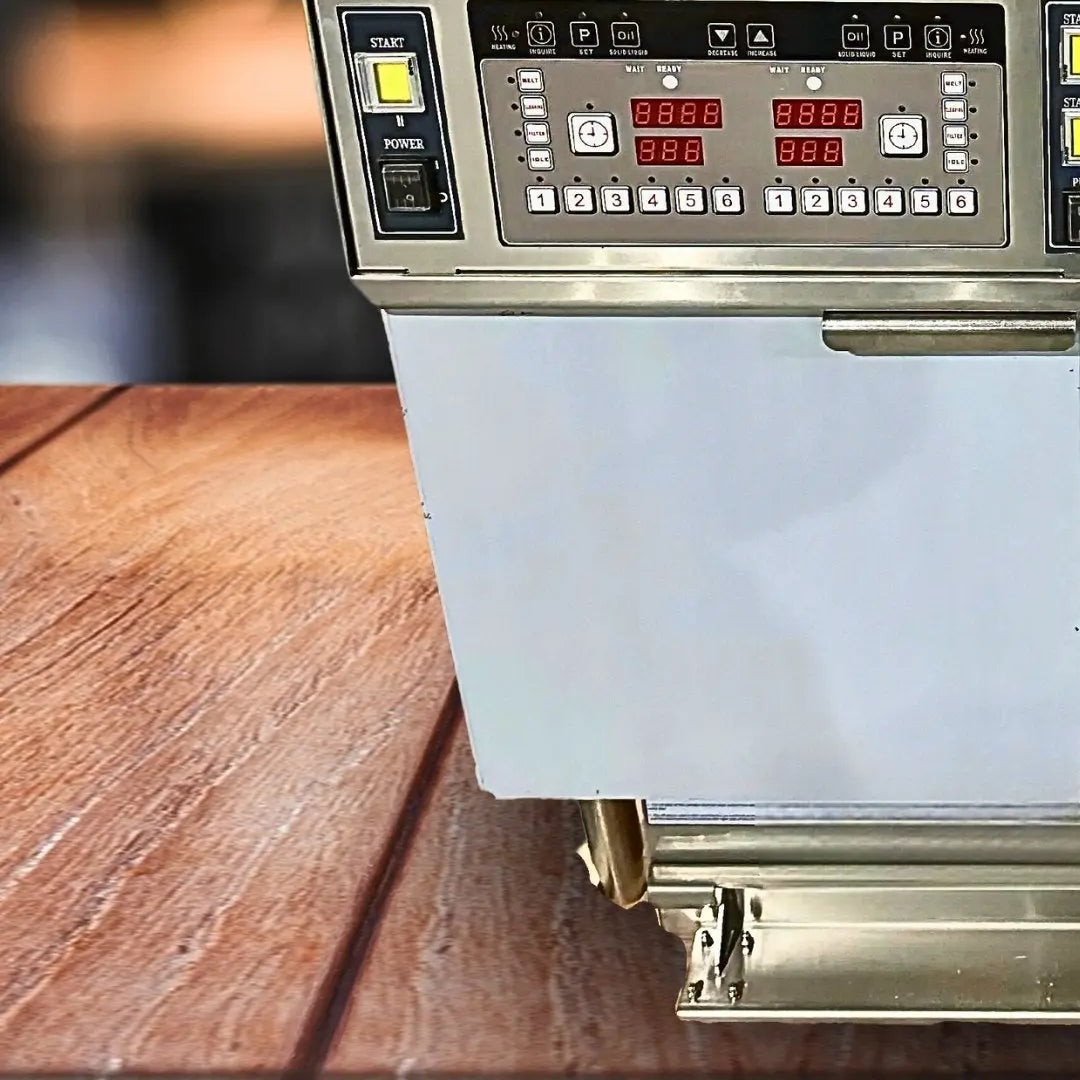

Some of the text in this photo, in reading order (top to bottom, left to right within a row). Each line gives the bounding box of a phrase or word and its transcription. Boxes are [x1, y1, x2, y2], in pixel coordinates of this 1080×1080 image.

[579, 28, 590, 42] P
[617, 30, 635, 40] Oil
[893, 32, 904, 44] P
[370, 38, 405, 48] START
[625, 65, 682, 73] WAIT READY
[769, 66, 826, 74] WAIT READY
[384, 138, 425, 150] POWER
[537, 193, 733, 207] 1 2 3 4 5 6
[775, 195, 966, 208] 1 2 3 4 5 6
